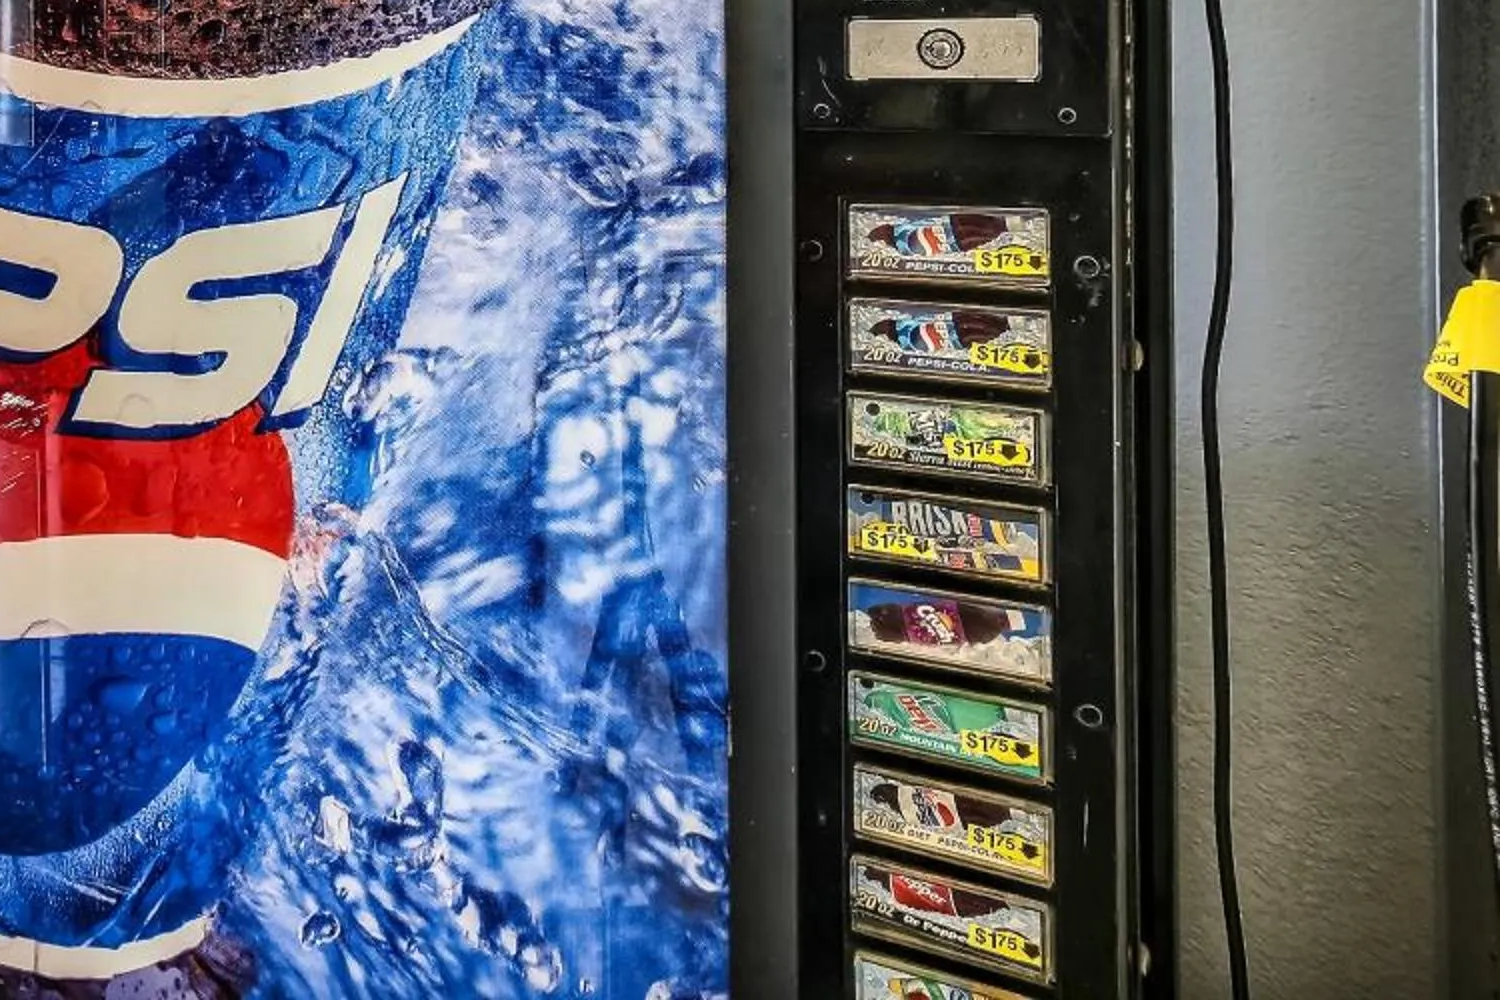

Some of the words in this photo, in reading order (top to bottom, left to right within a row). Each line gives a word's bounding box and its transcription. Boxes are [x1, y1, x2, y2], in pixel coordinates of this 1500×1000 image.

[861, 251, 883, 269] 20
[863, 346, 883, 362] 20
[867, 441, 888, 457] 20
[916, 604, 955, 646] Crush
[859, 716, 877, 733] 20
[857, 892, 878, 911] 20
[923, 918, 969, 944] Peppe
